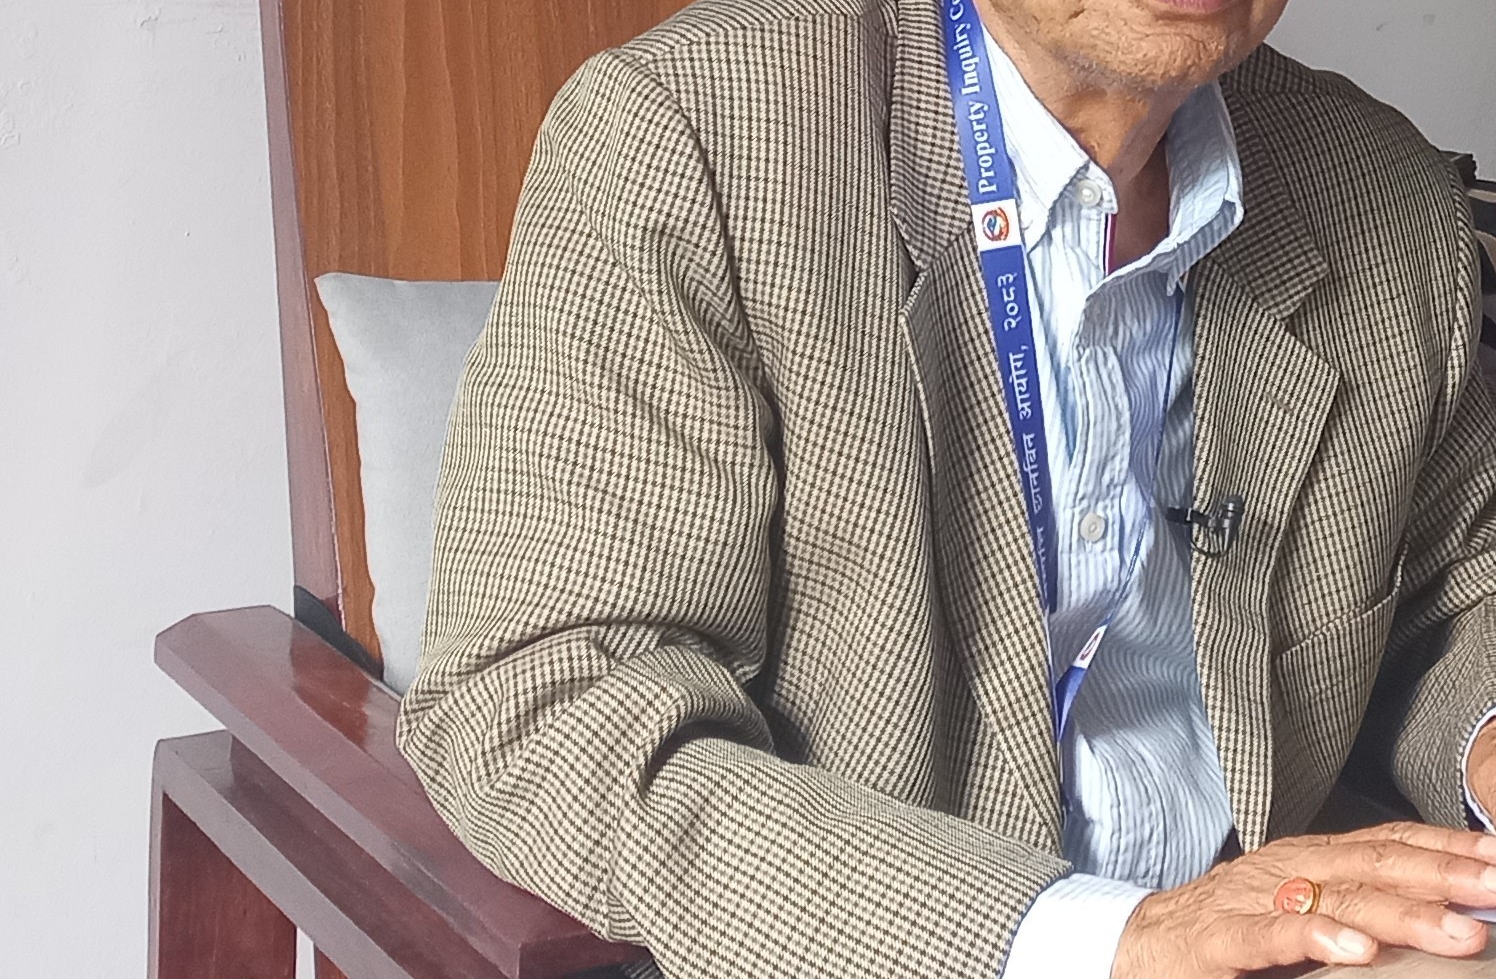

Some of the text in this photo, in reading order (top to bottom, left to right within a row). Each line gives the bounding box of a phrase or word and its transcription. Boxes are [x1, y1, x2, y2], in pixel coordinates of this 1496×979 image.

[952, 23, 981, 95] Inquiry
[967, 100, 997, 194] Property
[996, 272, 1021, 330] २०८३
